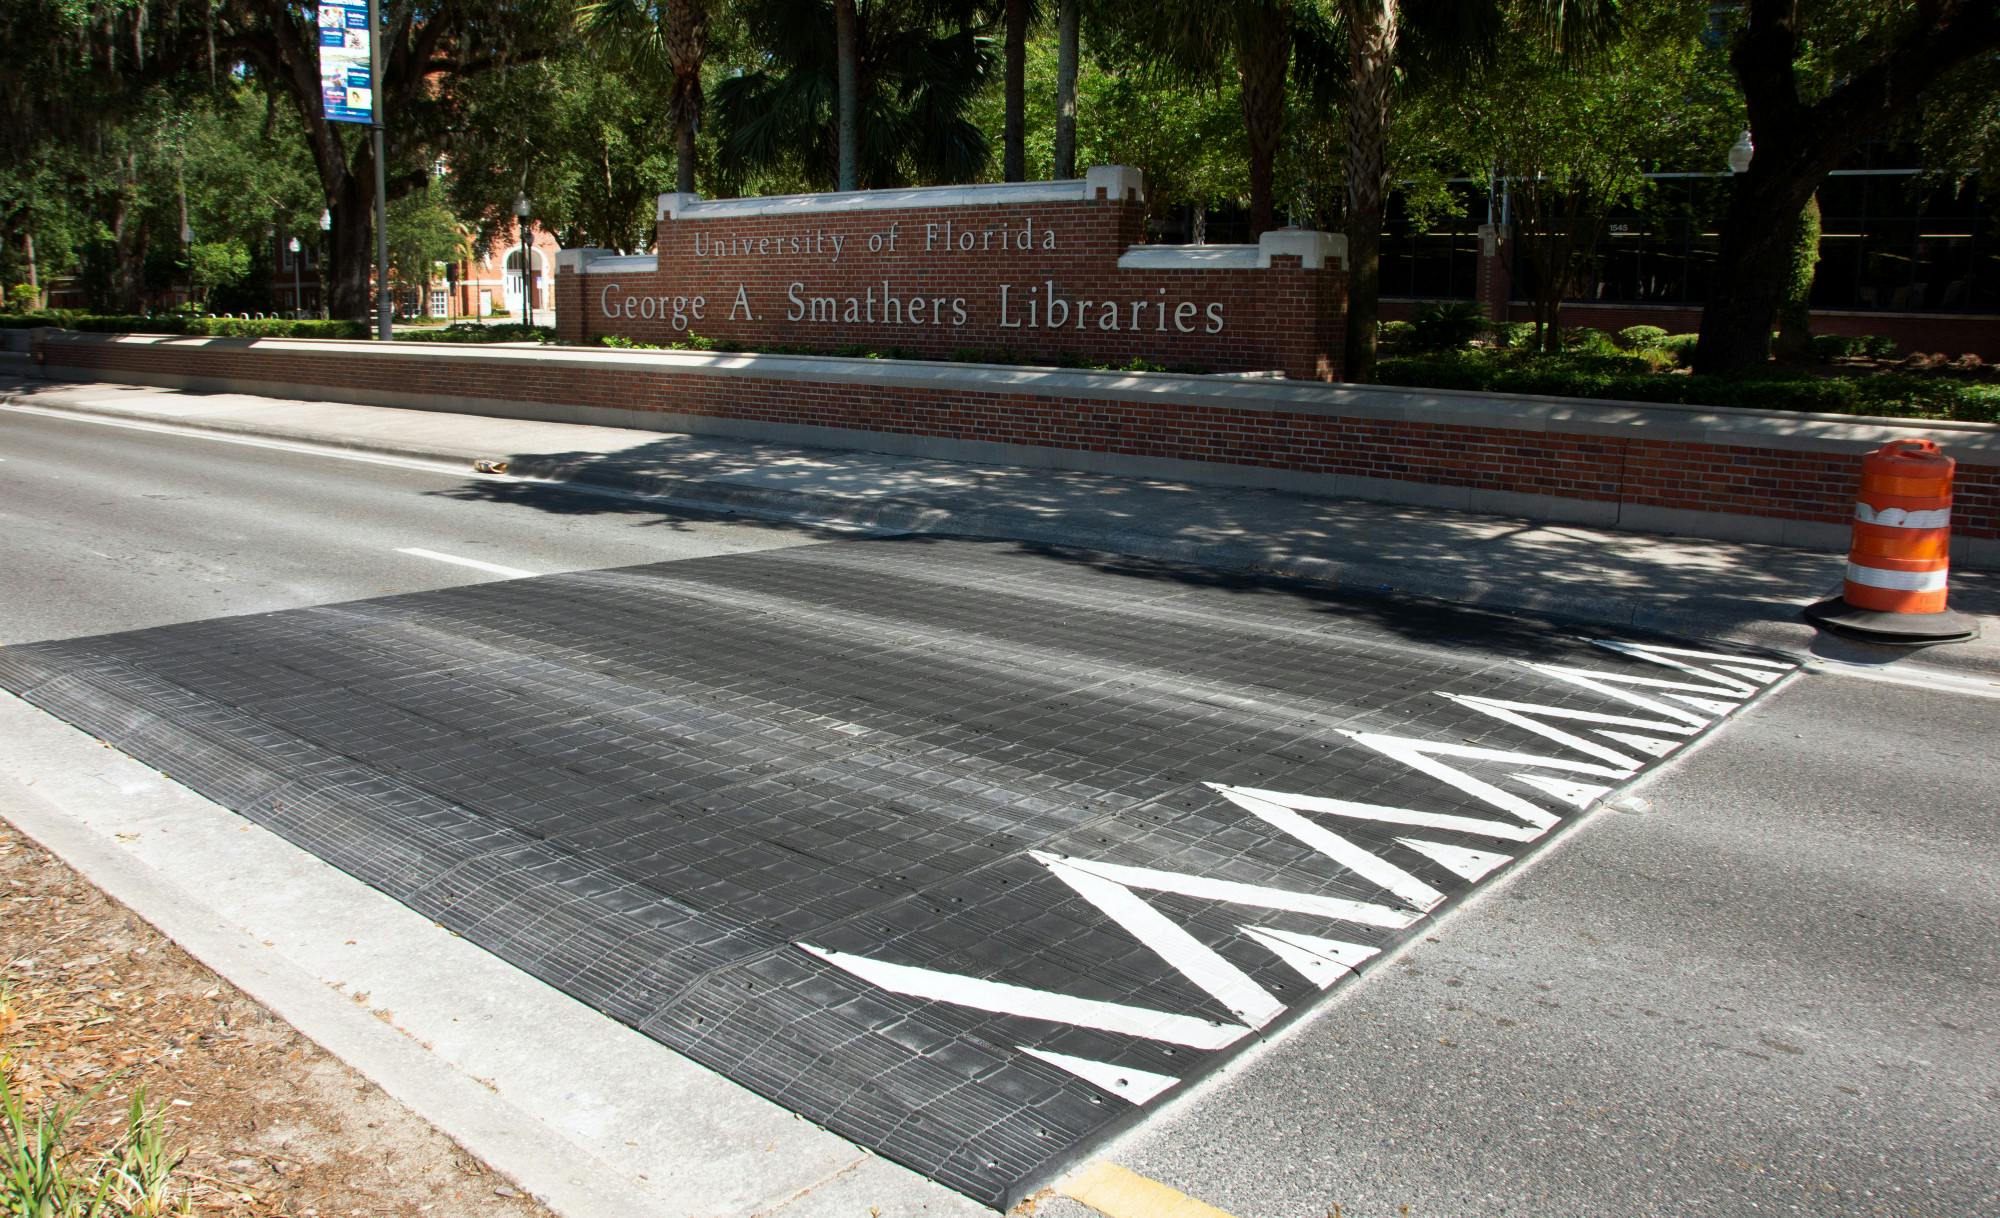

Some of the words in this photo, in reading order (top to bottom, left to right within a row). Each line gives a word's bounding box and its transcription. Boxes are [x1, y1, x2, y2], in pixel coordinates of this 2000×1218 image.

[694, 230, 845, 262] University
[868, 221, 898, 253] of
[925, 218, 1057, 251] Florida
[601, 283, 706, 331] George
[728, 283, 763, 321] A.
[787, 280, 967, 326] Smathers
[1000, 280, 1224, 334] Libraries
